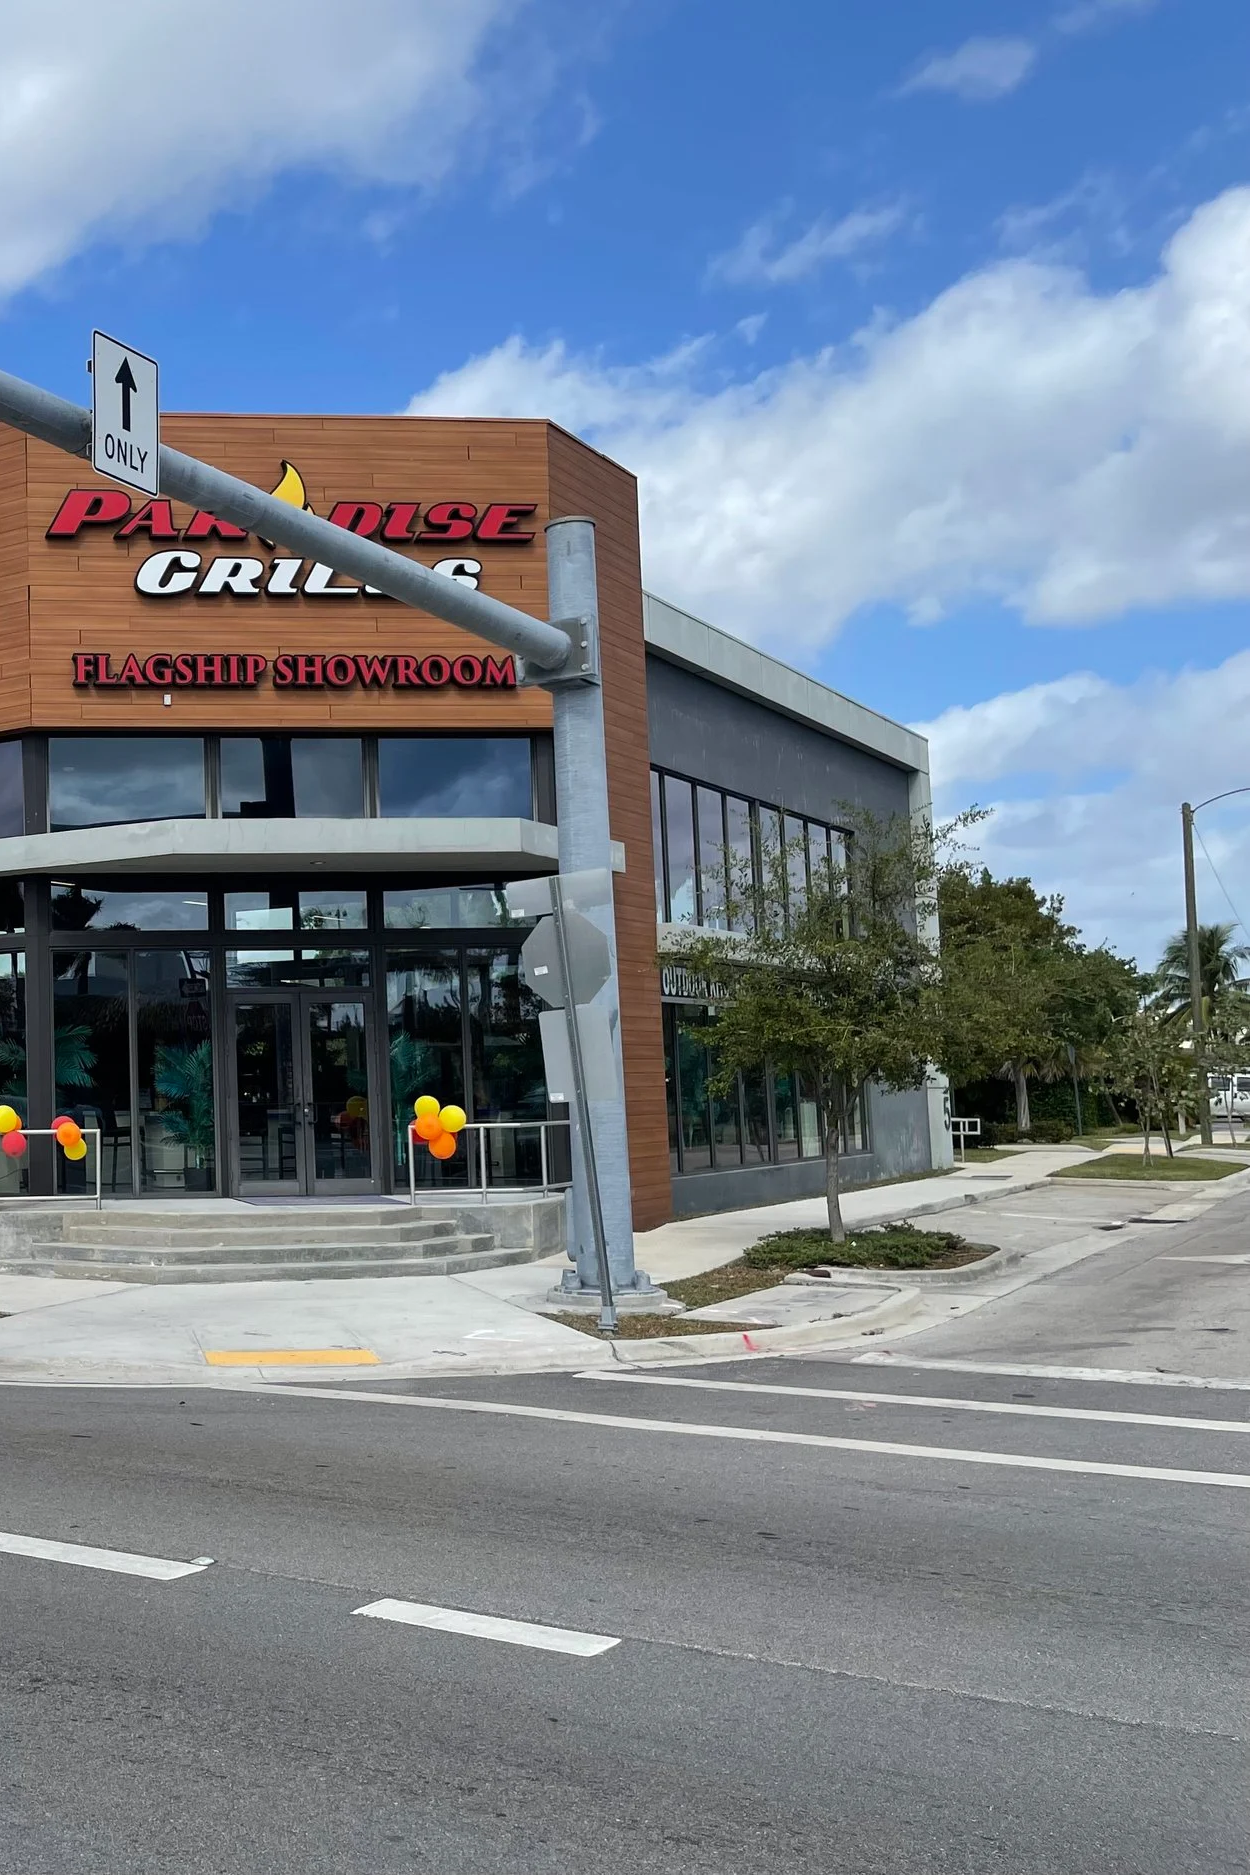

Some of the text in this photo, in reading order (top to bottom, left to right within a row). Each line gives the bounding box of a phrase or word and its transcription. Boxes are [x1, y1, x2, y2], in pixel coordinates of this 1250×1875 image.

[104, 433, 148, 474] ONLY
[72, 651, 518, 689] FLAGSHIP SHOWROOM
